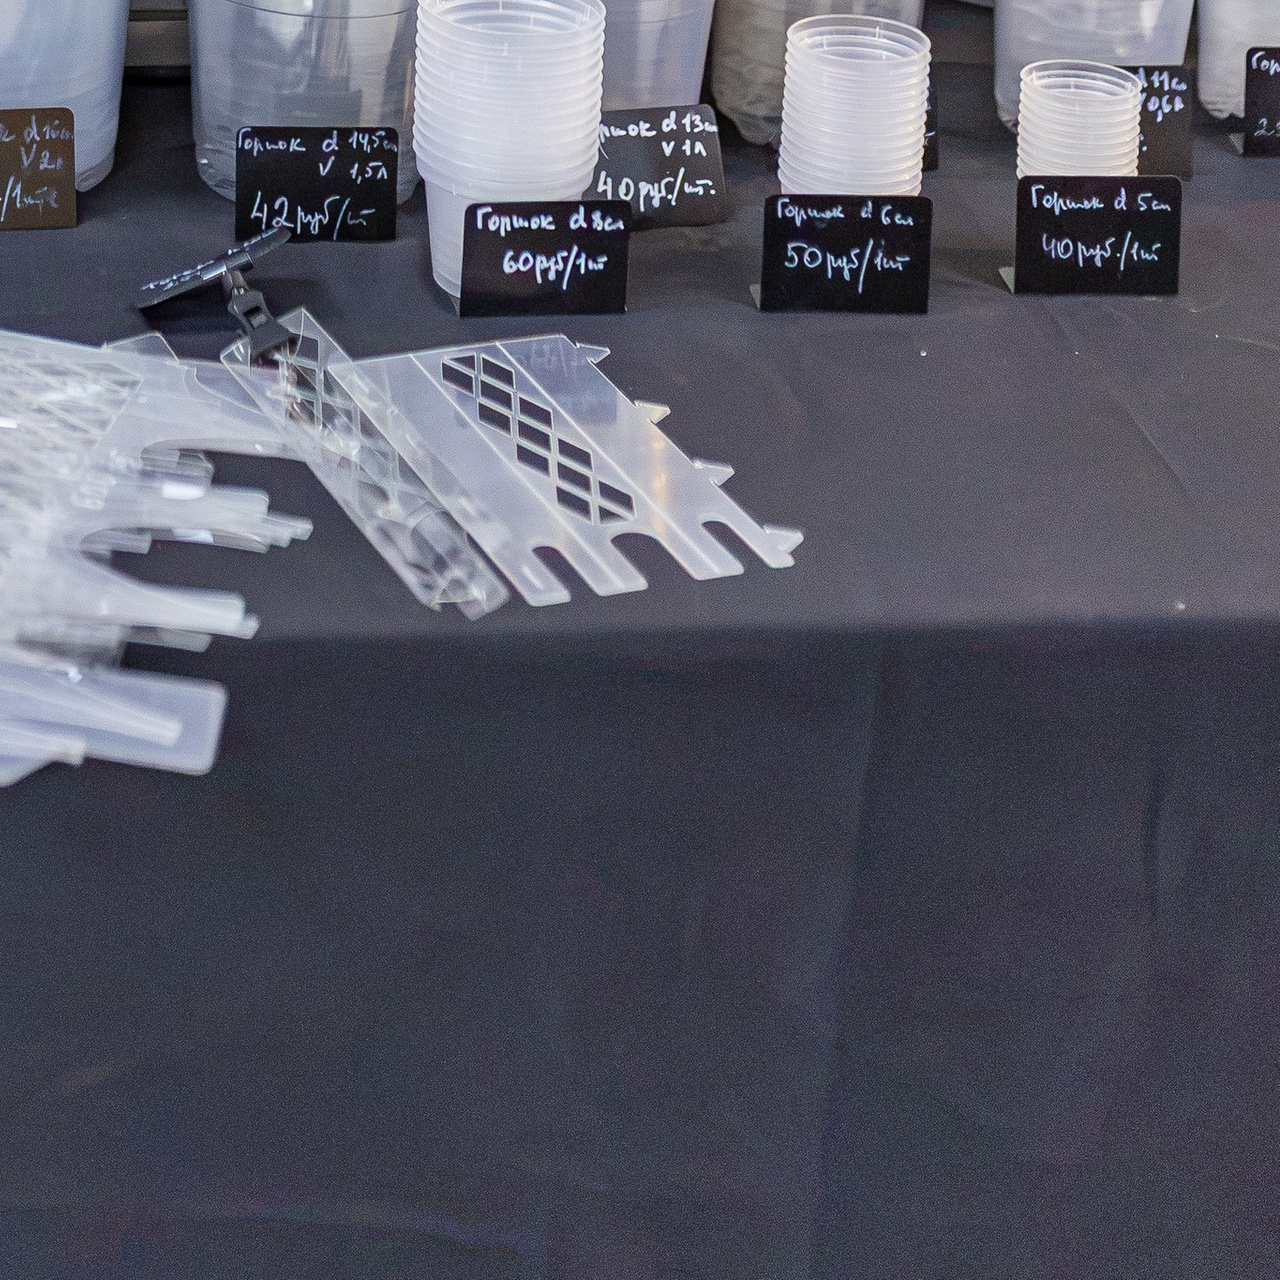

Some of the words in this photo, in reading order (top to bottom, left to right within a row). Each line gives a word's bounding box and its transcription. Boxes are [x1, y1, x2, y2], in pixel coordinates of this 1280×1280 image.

[238, 127, 307, 157] Горшок
[777, 197, 844, 227] Горшок
[1031, 184, 1104, 216] Горшок
[476, 206, 556, 237] Горшок
